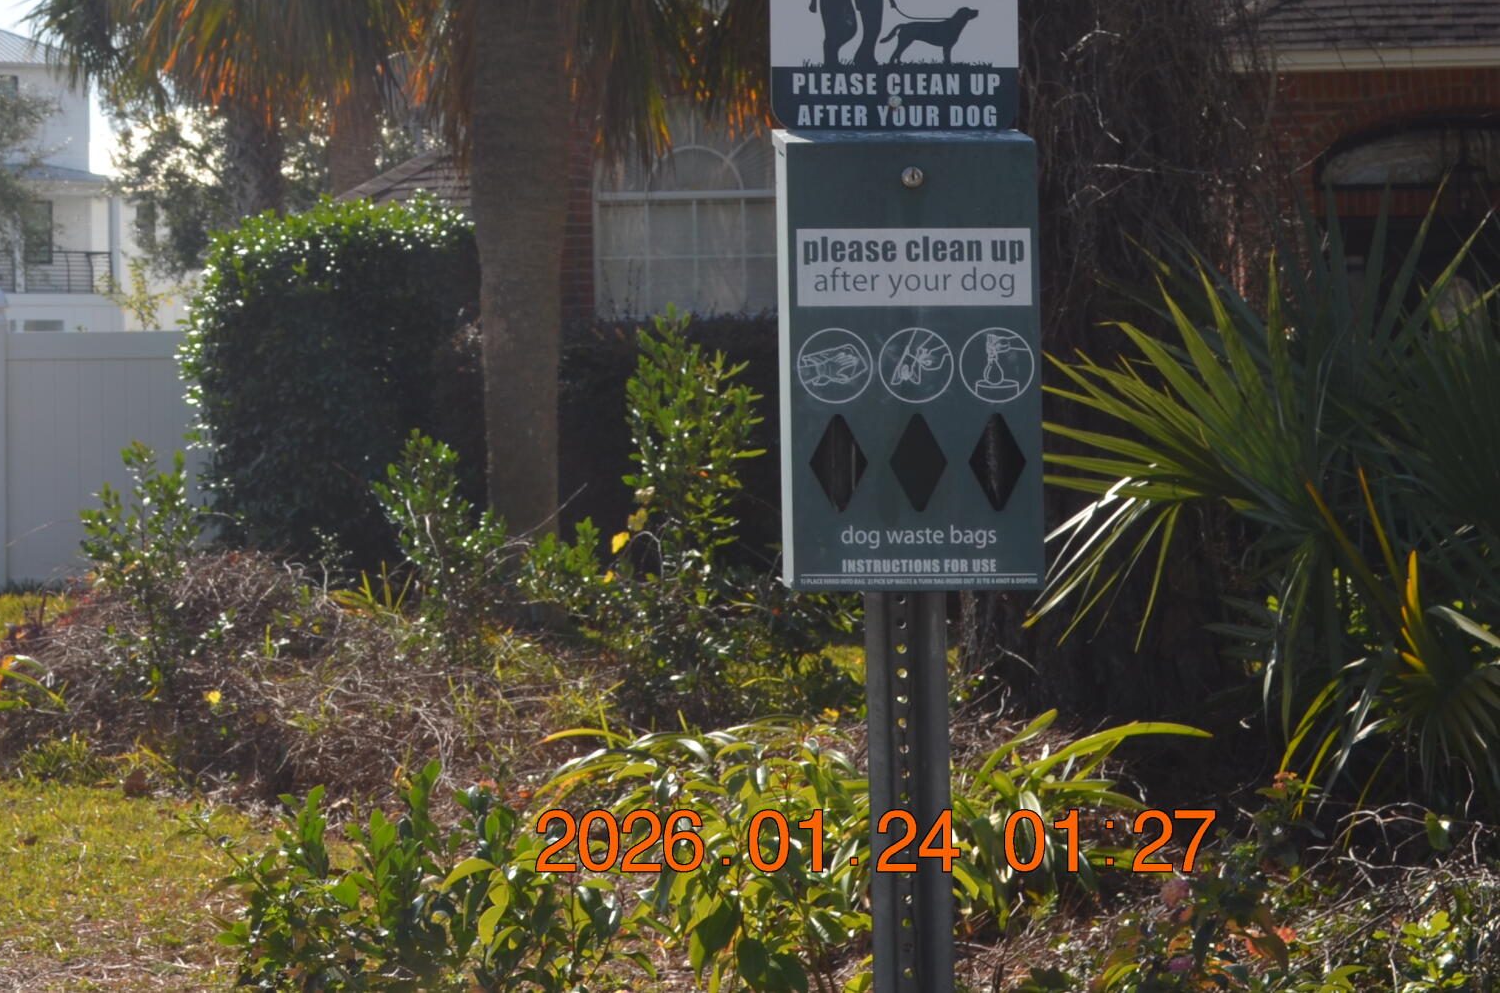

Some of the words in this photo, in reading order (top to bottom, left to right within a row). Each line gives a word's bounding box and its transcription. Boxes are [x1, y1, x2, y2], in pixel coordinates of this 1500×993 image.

[793, 73, 876, 95] PLEASE
[887, 73, 959, 95] CLEAN
[971, 74, 1000, 95] UP
[798, 105, 867, 126] AFTER
[877, 104, 939, 126] YOUR
[950, 105, 996, 126] DOG
[804, 237, 896, 265] please
[906, 236, 982, 262] clean
[991, 240, 1024, 264] up
[815, 267, 879, 291] after
[888, 274, 951, 298] your
[961, 267, 1014, 297] dog
[841, 526, 880, 549] dog
[887, 528, 944, 544] waste
[950, 525, 996, 548] bags
[843, 559, 940, 573] INSTRUCTIONS
[944, 559, 968, 572] FOR
[972, 559, 996, 572] USE
